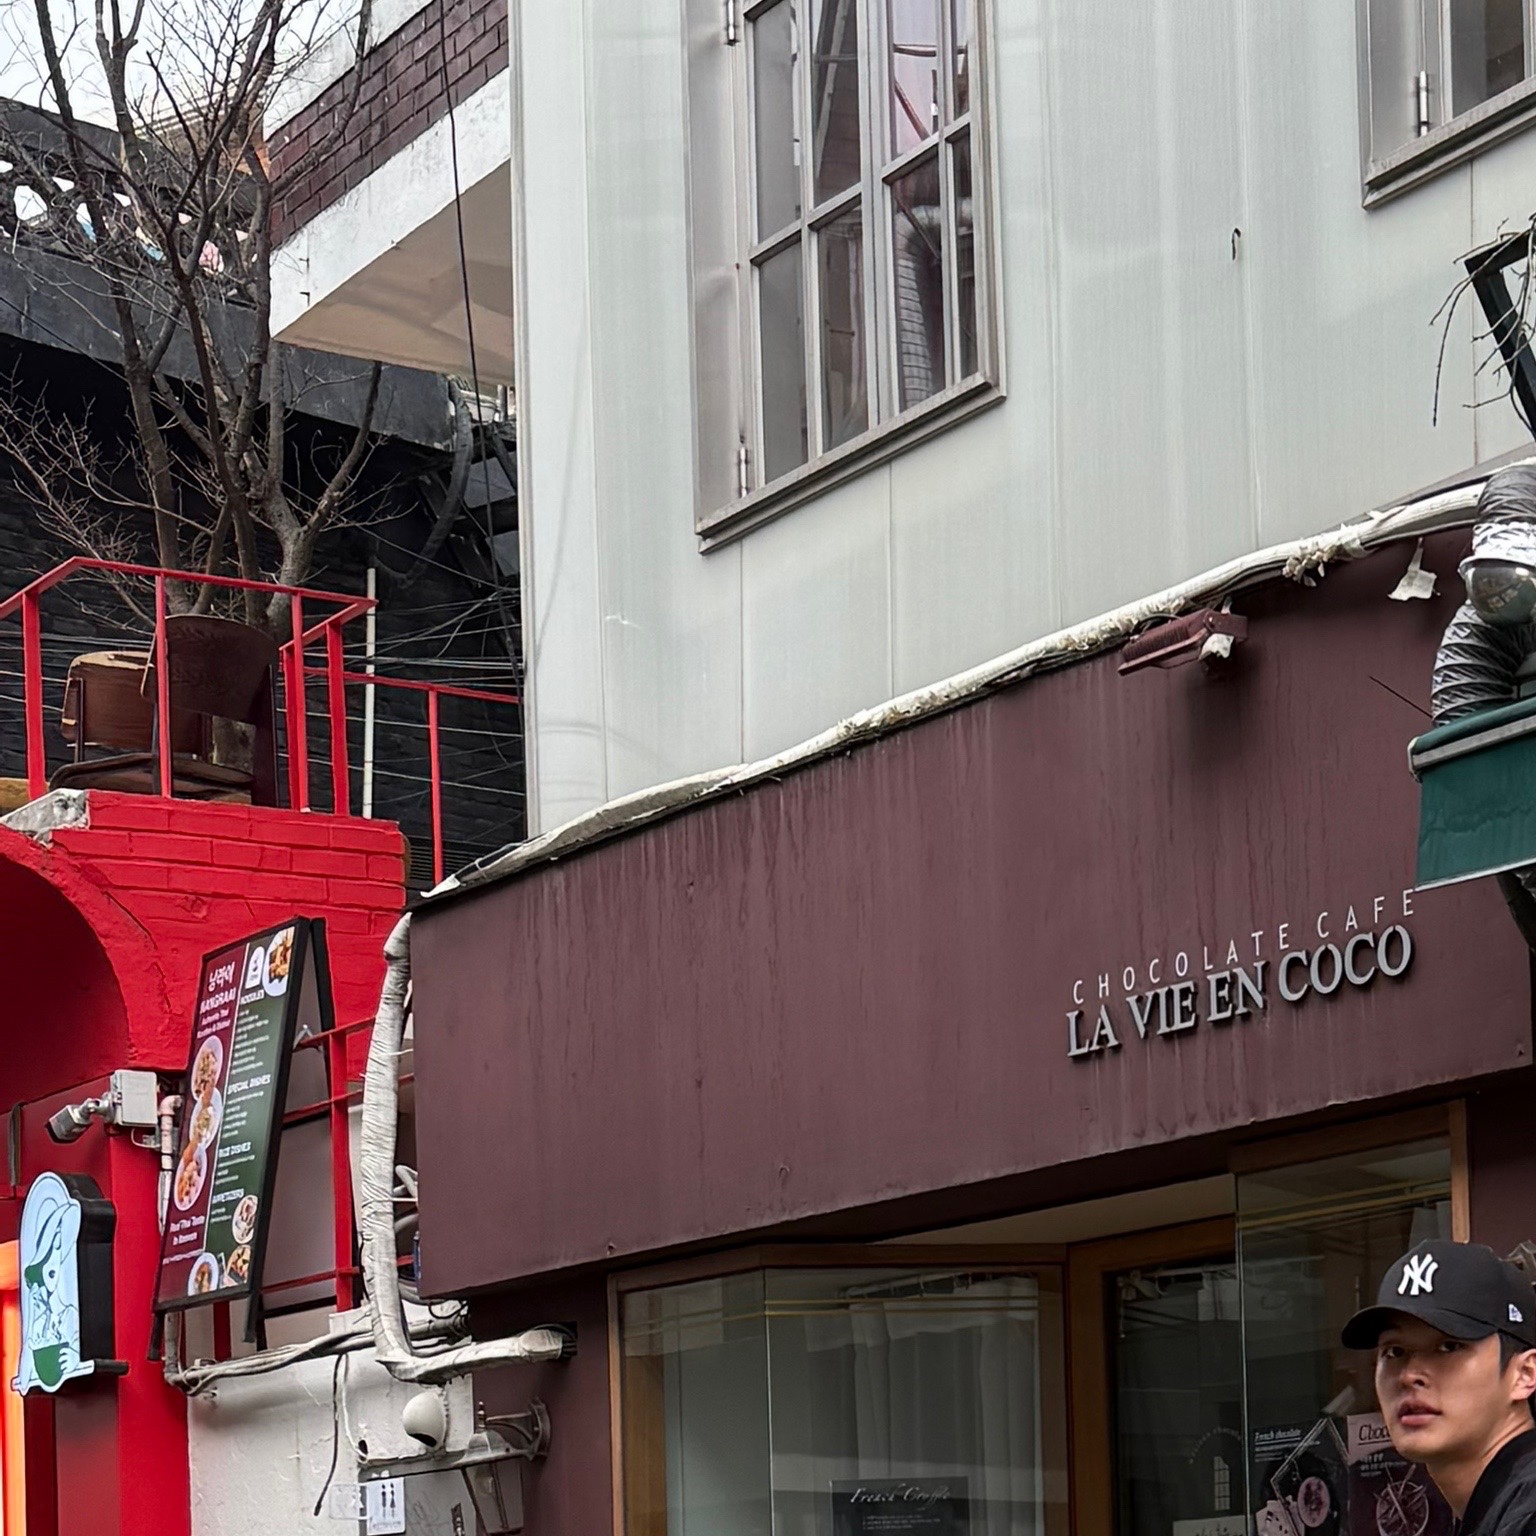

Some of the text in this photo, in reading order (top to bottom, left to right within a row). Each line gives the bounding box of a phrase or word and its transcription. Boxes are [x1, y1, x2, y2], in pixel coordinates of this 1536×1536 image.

[1066, 925, 1412, 1057] LA VIE EN COCO
[1072, 888, 1414, 1005] CHOCOLATE CAFE
[1397, 1253, 1439, 1296] NY
